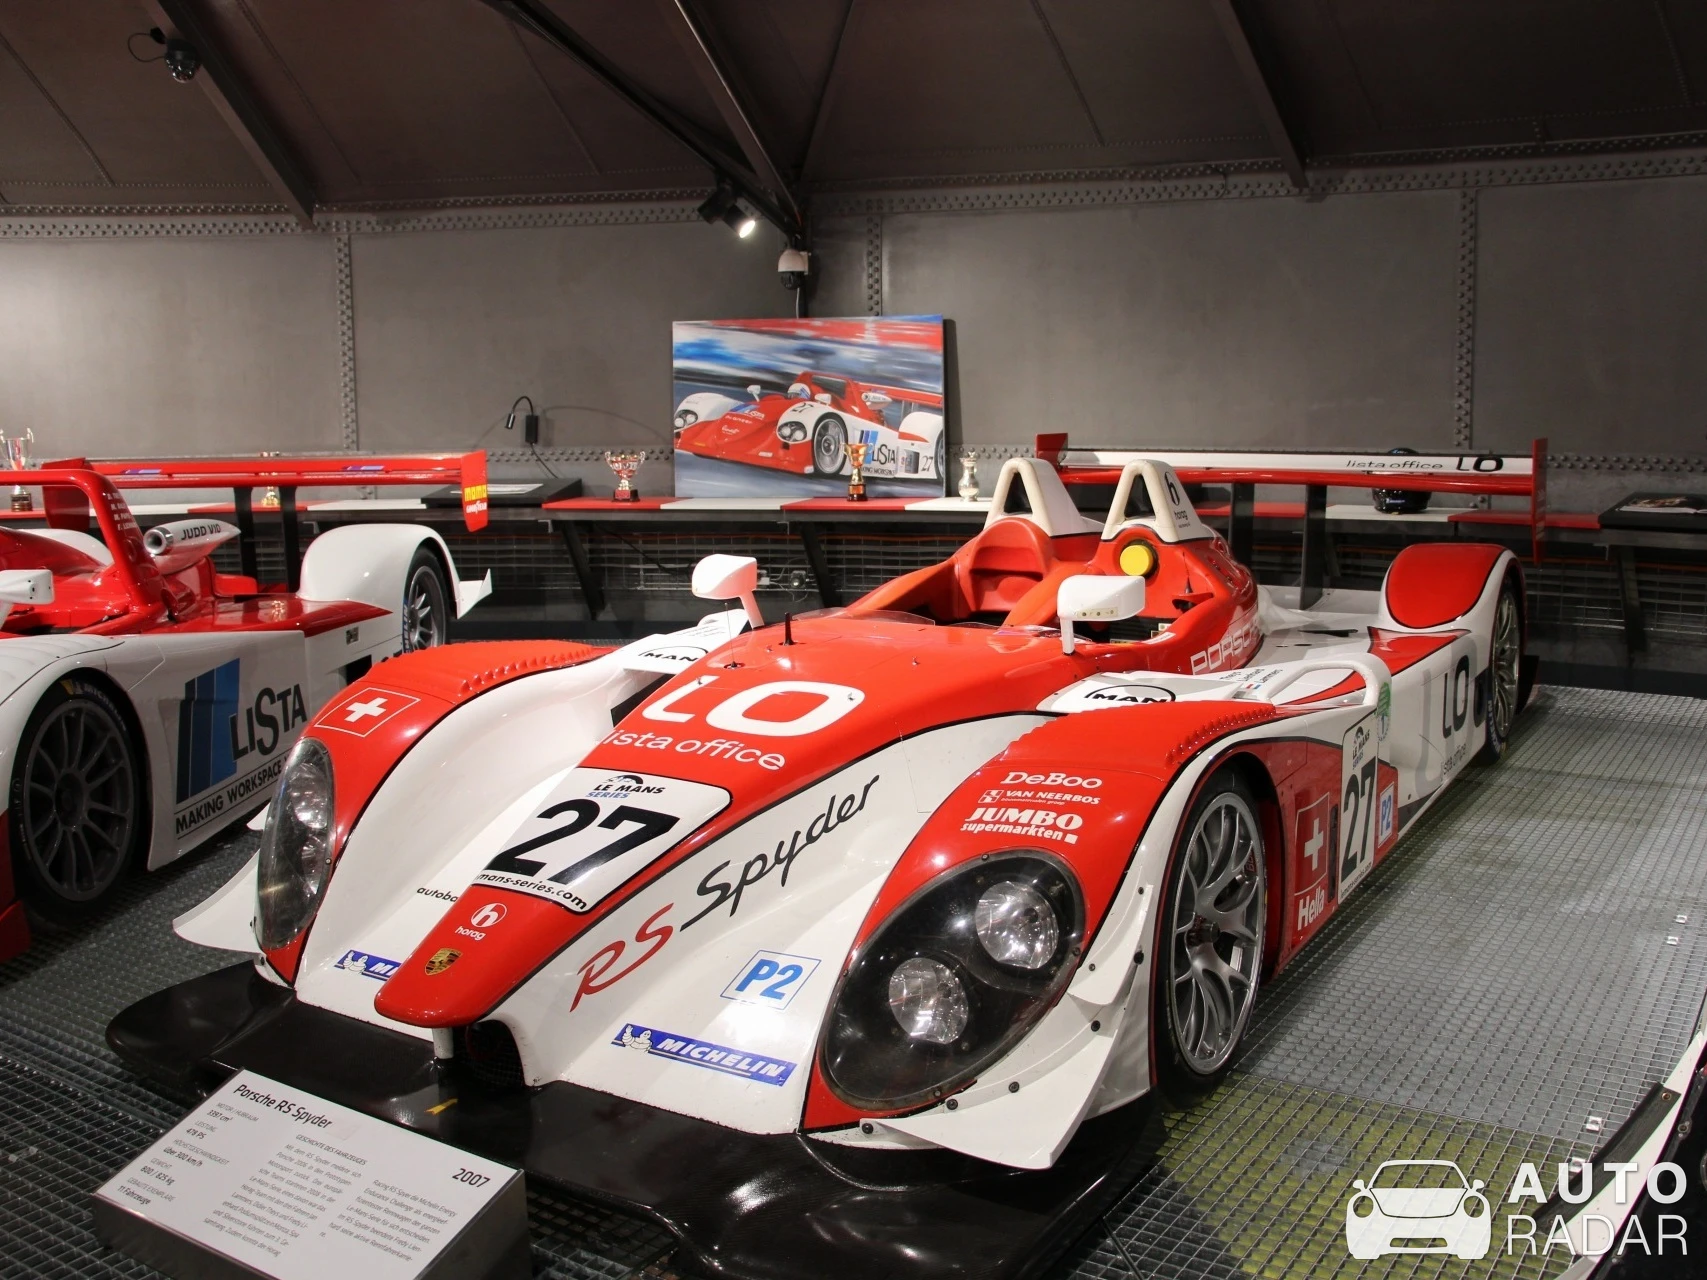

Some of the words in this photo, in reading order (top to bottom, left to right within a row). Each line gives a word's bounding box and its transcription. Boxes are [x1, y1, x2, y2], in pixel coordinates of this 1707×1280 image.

[872, 444, 896, 465] LISTA
[921, 455, 934, 472] 27
[1346, 460, 1386, 468] lista
[1389, 460, 1443, 469] office
[1456, 456, 1504, 473] LO
[181, 526, 207, 540] JUDD
[644, 653, 699, 662] MAN
[1094, 692, 1167, 704] MAN
[1442, 653, 1470, 739] LO
[642, 675, 866, 737] LO
[229, 683, 308, 762] LISTA
[675, 738, 786, 771] office
[617, 784, 666, 795] MANS
[1000, 771, 1102, 789] DeBoo
[176, 794, 224, 834] MAKING
[226, 759, 283, 805] WORKSPACE
[585, 791, 631, 799] SERIES
[1006, 790, 1034, 798] VAN
[1036, 792, 1101, 805] NEERBOS
[965, 807, 1083, 830] JUMBO
[1341, 756, 1376, 883] 27
[1380, 794, 1394, 836] P2
[961, 822, 1063, 841] supermarkten
[482, 798, 681, 886] 27
[476, 873, 588, 911] mans-series.com
[570, 902, 675, 1013] RS
[680, 774, 880, 932] Spyder
[1297, 886, 1325, 931] Hella
[455, 925, 486, 941] horag
[369, 962, 402, 974] MI
[734, 958, 803, 1000] P2
[656, 1038, 787, 1078] MICHELIN
[207, 1109, 223, 1118] 3397
[234, 1084, 276, 1107] Porsche
[274, 1100, 296, 1114] RS
[292, 1107, 332, 1128] Spyder
[186, 1128, 199, 1136] 478
[196, 1131, 207, 1140] PS
[163, 1147, 177, 1156] über
[175, 1151, 189, 1160] 300
[186, 1156, 203, 1166] km/h
[276, 1151, 295, 1163] Porsche
[293, 1148, 306, 1156] dem
[313, 1155, 331, 1166] Spyder
[296, 1134, 326, 1149] GESCHICHTE
[323, 1145, 336, 1153] DES
[334, 1149, 367, 1165] FAHRZEUGES
[140, 1165, 154, 1175] 800
[155, 1172, 169, 1181] 825
[165, 1177, 175, 1186] kg
[268, 1160, 293, 1173] Motorsport
[270, 1172, 286, 1182] Teams
[452, 1168, 489, 1187] 2007
[123, 1188, 151, 1205] Fahrzeuge
[363, 1187, 390, 1202] Endurance
[389, 1198, 414, 1212] Challenge
[372, 1179, 390, 1191] Racing
[388, 1185, 399, 1193] RS
[418, 1197, 440, 1210] Michelin
[438, 1205, 457, 1218] Energy
[382, 1207, 412, 1223] Rennwagen
[419, 1224, 440, 1234] ganzen
[388, 1223, 400, 1231] sich
[339, 1227, 354, 1236] seine
[353, 1233, 370, 1243] aktive
[344, 1216, 355, 1224] RS
[352, 1219, 371, 1231] Spyder
[370, 1227, 394, 1241] beendete
[393, 1236, 409, 1248] Fredy
